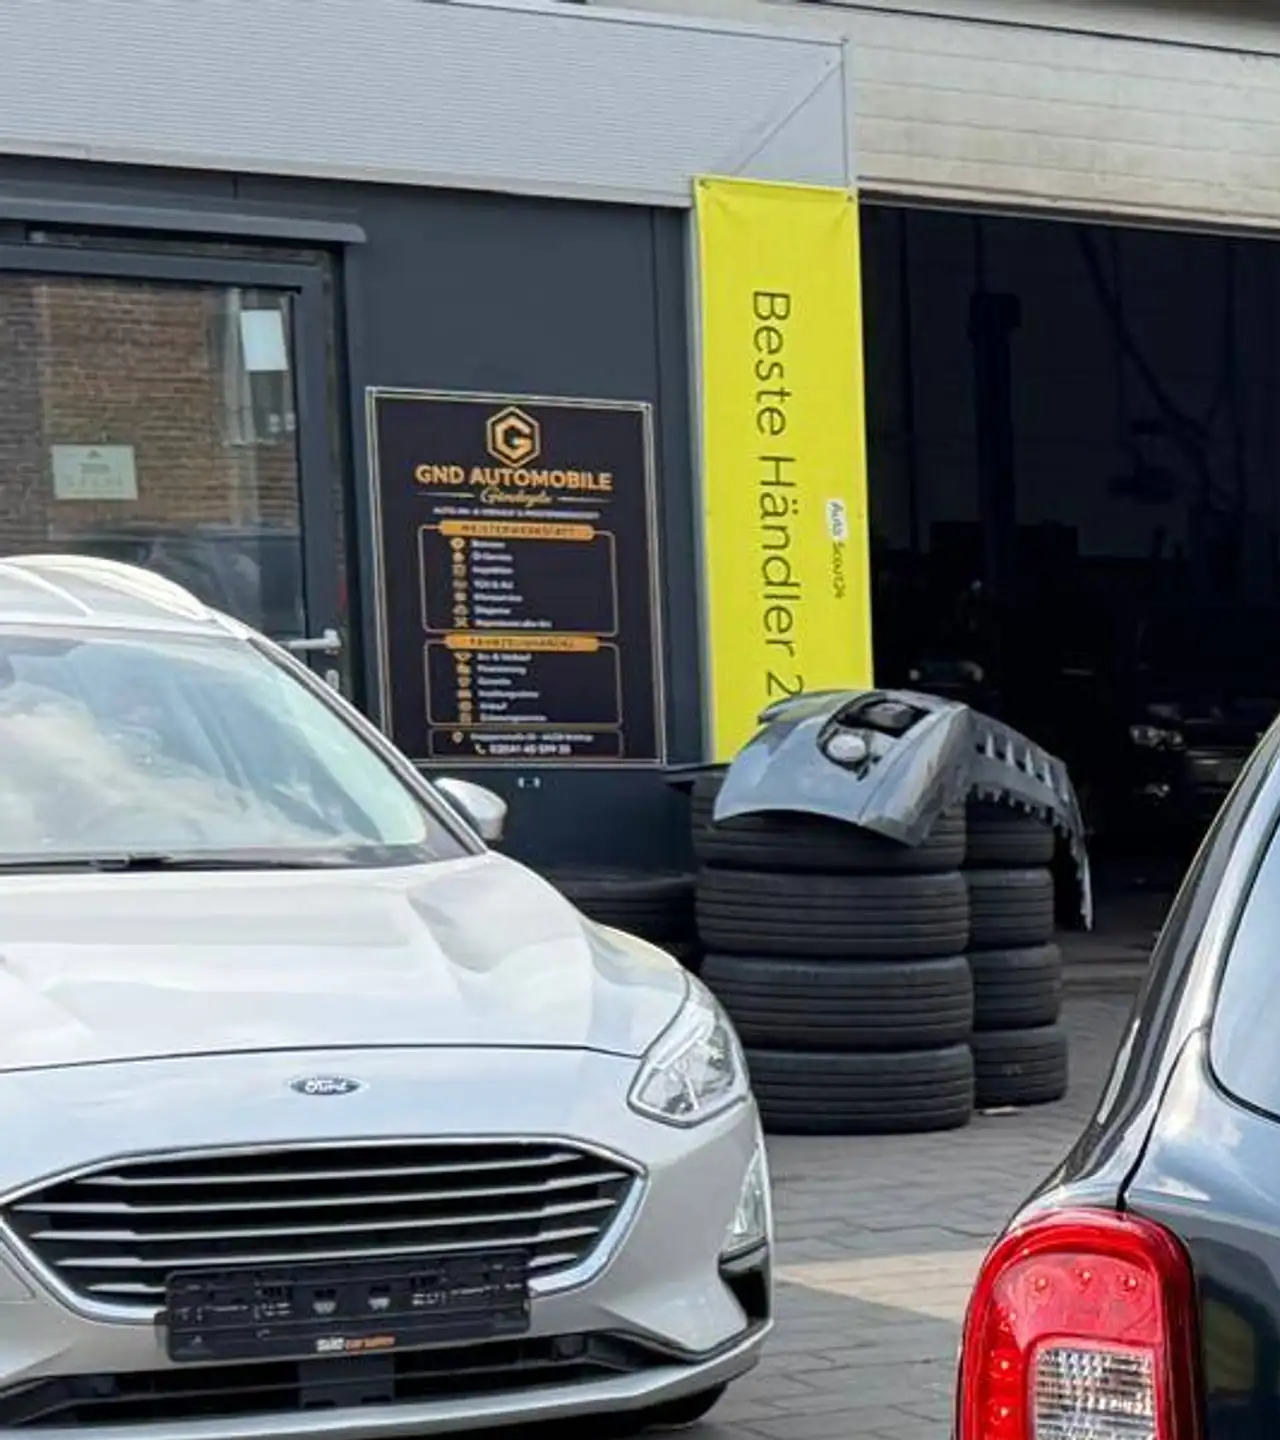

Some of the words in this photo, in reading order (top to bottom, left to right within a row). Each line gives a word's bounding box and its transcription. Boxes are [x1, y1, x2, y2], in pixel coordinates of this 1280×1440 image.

[752, 290, 792, 436] Beste
[415, 465, 465, 484] GND
[470, 467, 613, 491] AUTOMOBILE
[757, 455, 801, 655] Händler
